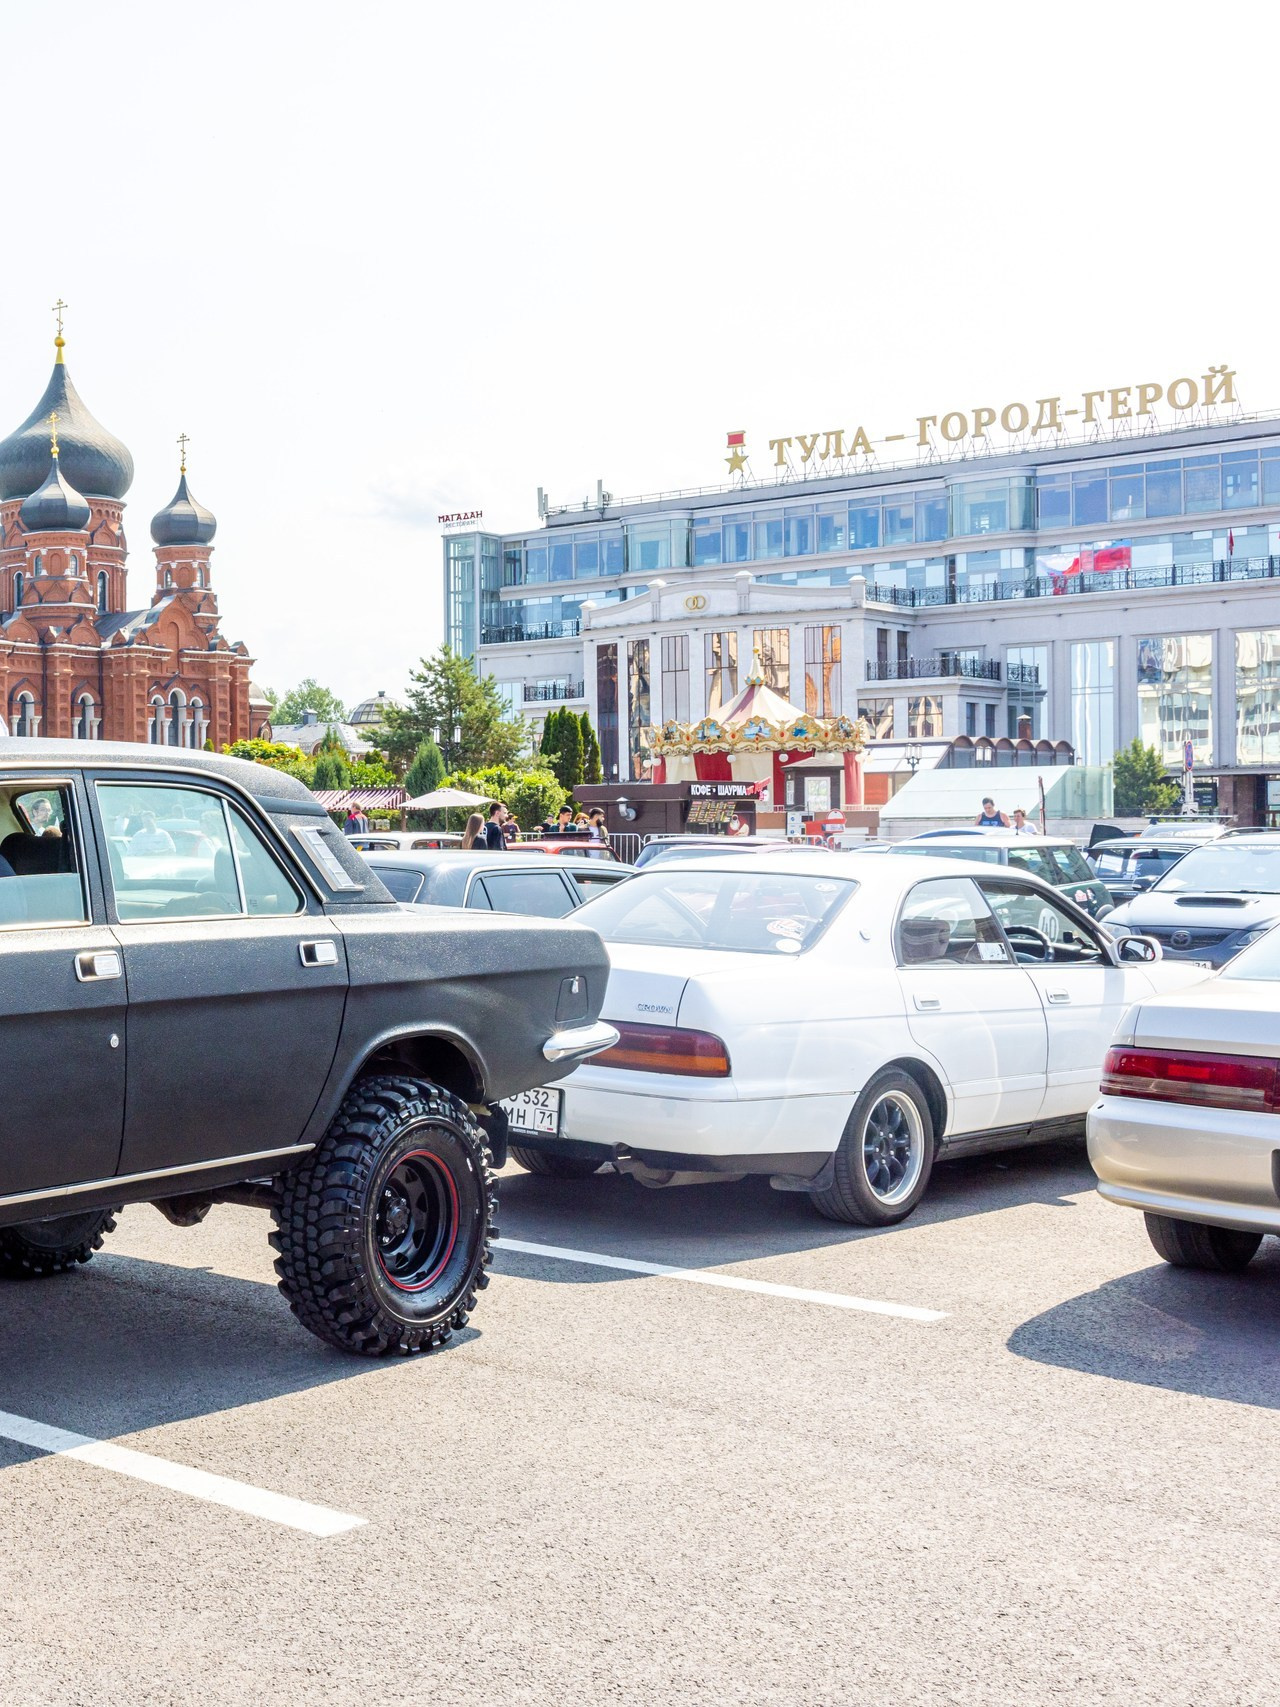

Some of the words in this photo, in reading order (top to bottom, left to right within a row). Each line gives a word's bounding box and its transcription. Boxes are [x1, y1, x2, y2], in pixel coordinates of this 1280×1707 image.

[768, 426, 875, 467] ТУЛА
[916, 364, 1237, 447] ГОРОД-ГЕРОЙ
[437, 510, 483, 523] МАГАДАН
[690, 784, 712, 796] КОФЕ
[717, 784, 748, 797] ШАУРМА
[637, 1003, 673, 1014] CROWN
[523, 1089, 549, 1108] 532
[539, 1111, 553, 1126] 71
